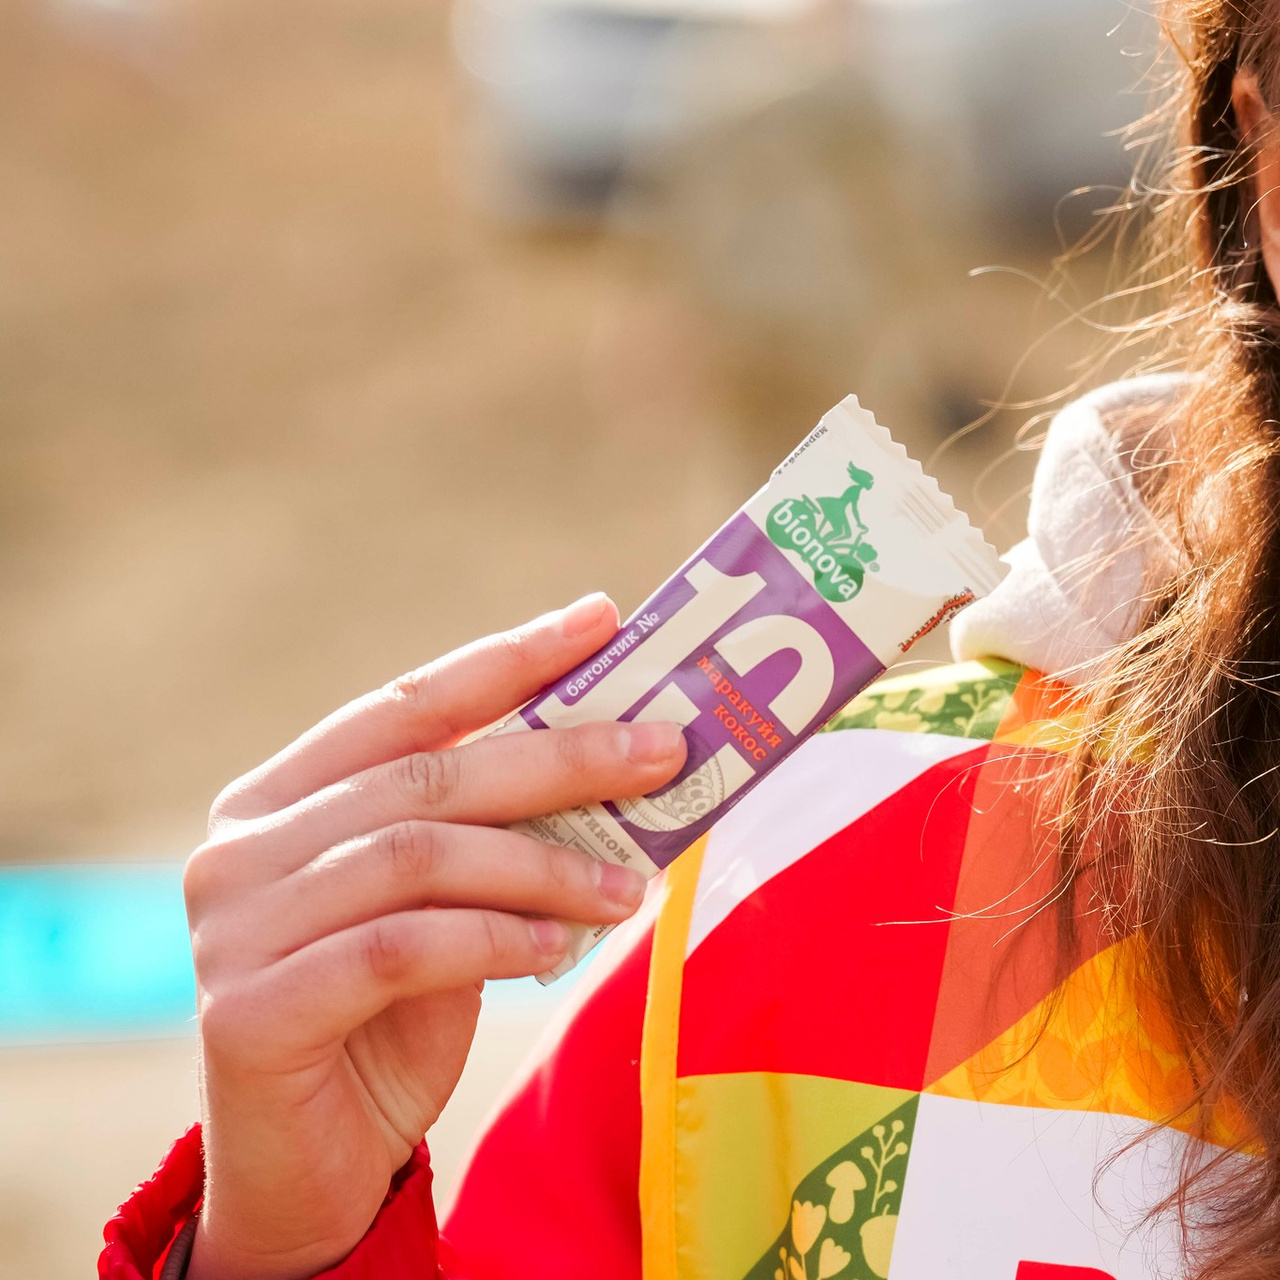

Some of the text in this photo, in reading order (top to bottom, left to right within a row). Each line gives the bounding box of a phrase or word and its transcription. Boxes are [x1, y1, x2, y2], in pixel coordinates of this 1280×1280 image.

[772, 500, 858, 599] bionova
[565, 612, 661, 697] батончик №
[697, 656, 783, 749] маракуйя
[713, 704, 767, 761] кокос
